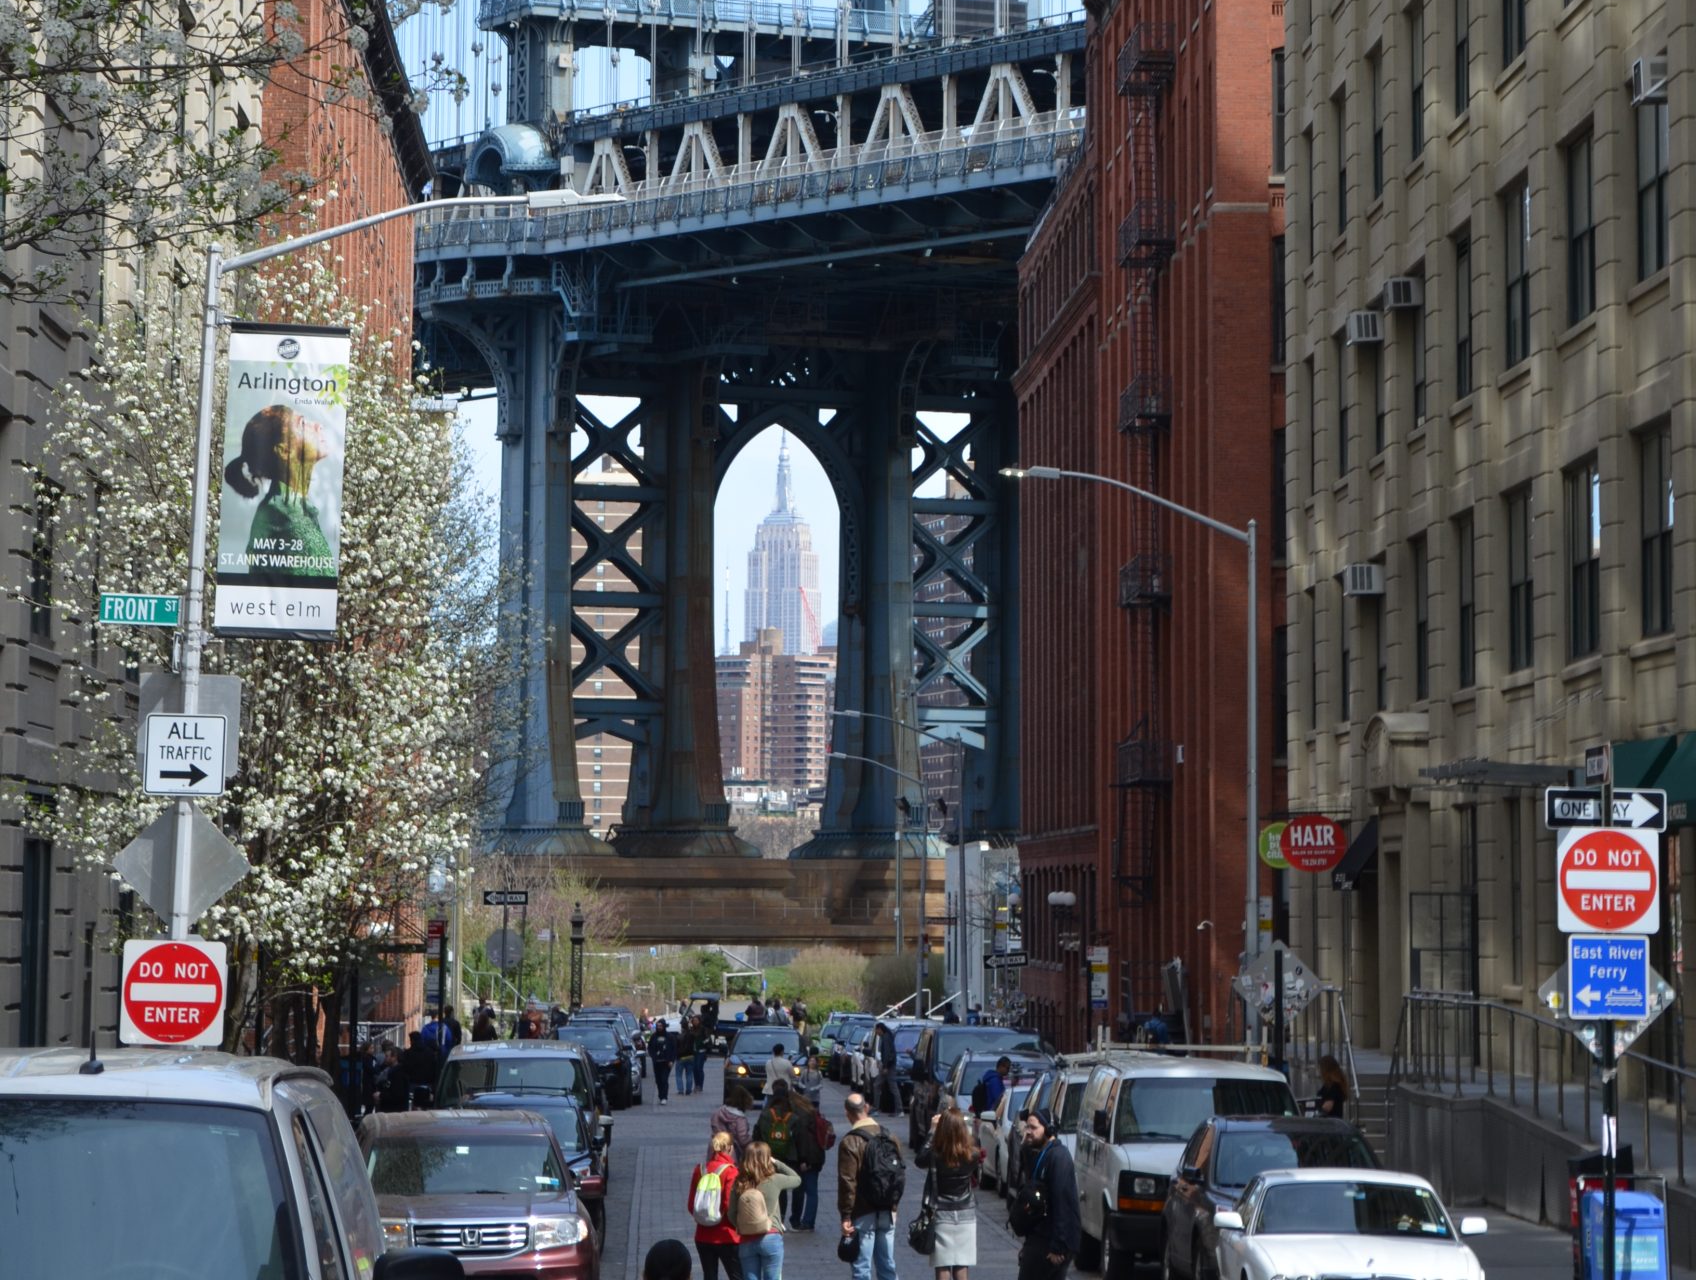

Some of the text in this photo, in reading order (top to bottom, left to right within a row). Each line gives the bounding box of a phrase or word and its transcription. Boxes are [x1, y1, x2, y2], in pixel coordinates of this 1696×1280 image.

[238, 372, 336, 394] Arlington
[253, 538, 276, 550] MAY
[221, 553, 335, 568] ST. ANN'S WAREHOUSE
[104, 597, 177, 620] FRONT ST
[230, 600, 320, 617] west elm
[168, 722, 205, 740] ALL
[159, 745, 212, 761] TRAFFIC
[1561, 802, 1630, 817] ONE AY
[1290, 825, 1335, 847] HAIR
[1574, 848, 1641, 867] DO NOT
[1581, 894, 1636, 911] ENTER
[1573, 946, 1643, 960] East River
[139, 962, 209, 979] DO NOT
[1590, 965, 1627, 982] Ferry
[144, 1007, 200, 1023] ENTER
